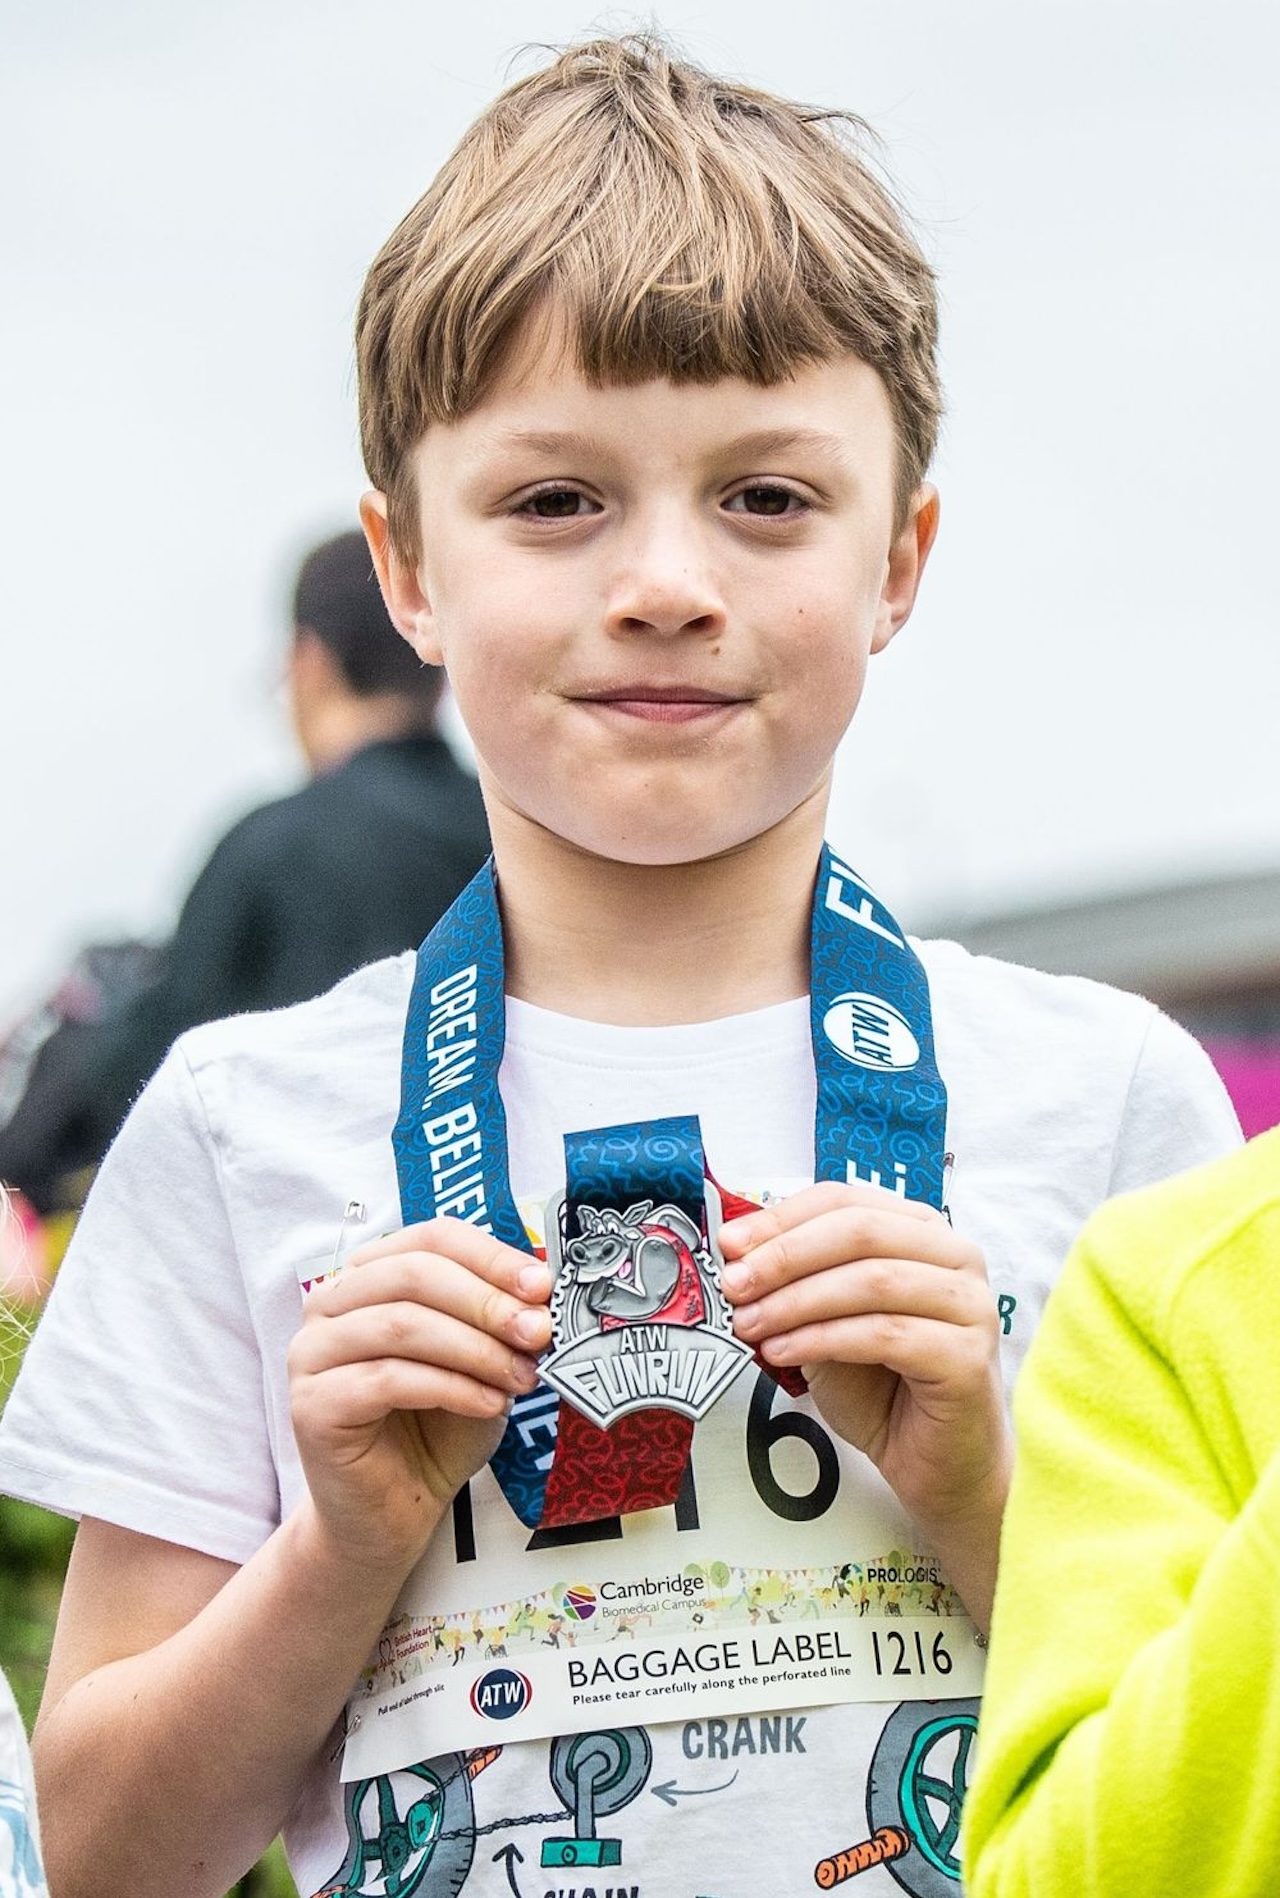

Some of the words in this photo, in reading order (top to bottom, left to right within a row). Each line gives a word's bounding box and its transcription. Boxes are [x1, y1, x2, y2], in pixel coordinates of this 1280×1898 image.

[421, 963, 478, 1111] DREAM,
[851, 1003, 894, 1067] ATW
[422, 1101, 494, 1234] BELIE
[620, 1325, 668, 1354] ATW
[551, 1349, 741, 1415] FUNRUN
[600, 1573, 704, 1600] Cambridge
[602, 1601, 660, 1618] Biomedical
[662, 1598, 706, 1611] Campus
[396, 1640, 430, 1660] Foundation
[412, 1625, 433, 1639] Heart
[568, 1642, 741, 1689] BAGGAGE
[751, 1631, 852, 1667] LABEL
[871, 1630, 953, 1676] 1216
[480, 1680, 521, 1709] ATW
[572, 1691, 612, 1706] Please
[615, 1688, 641, 1701] tear
[645, 1681, 697, 1697] carefully
[701, 1677, 735, 1691] along
[738, 1674, 759, 1686] the
[762, 1666, 827, 1685] perforated
[830, 1665, 851, 1677] line
[681, 1715, 808, 1760] CRANK
